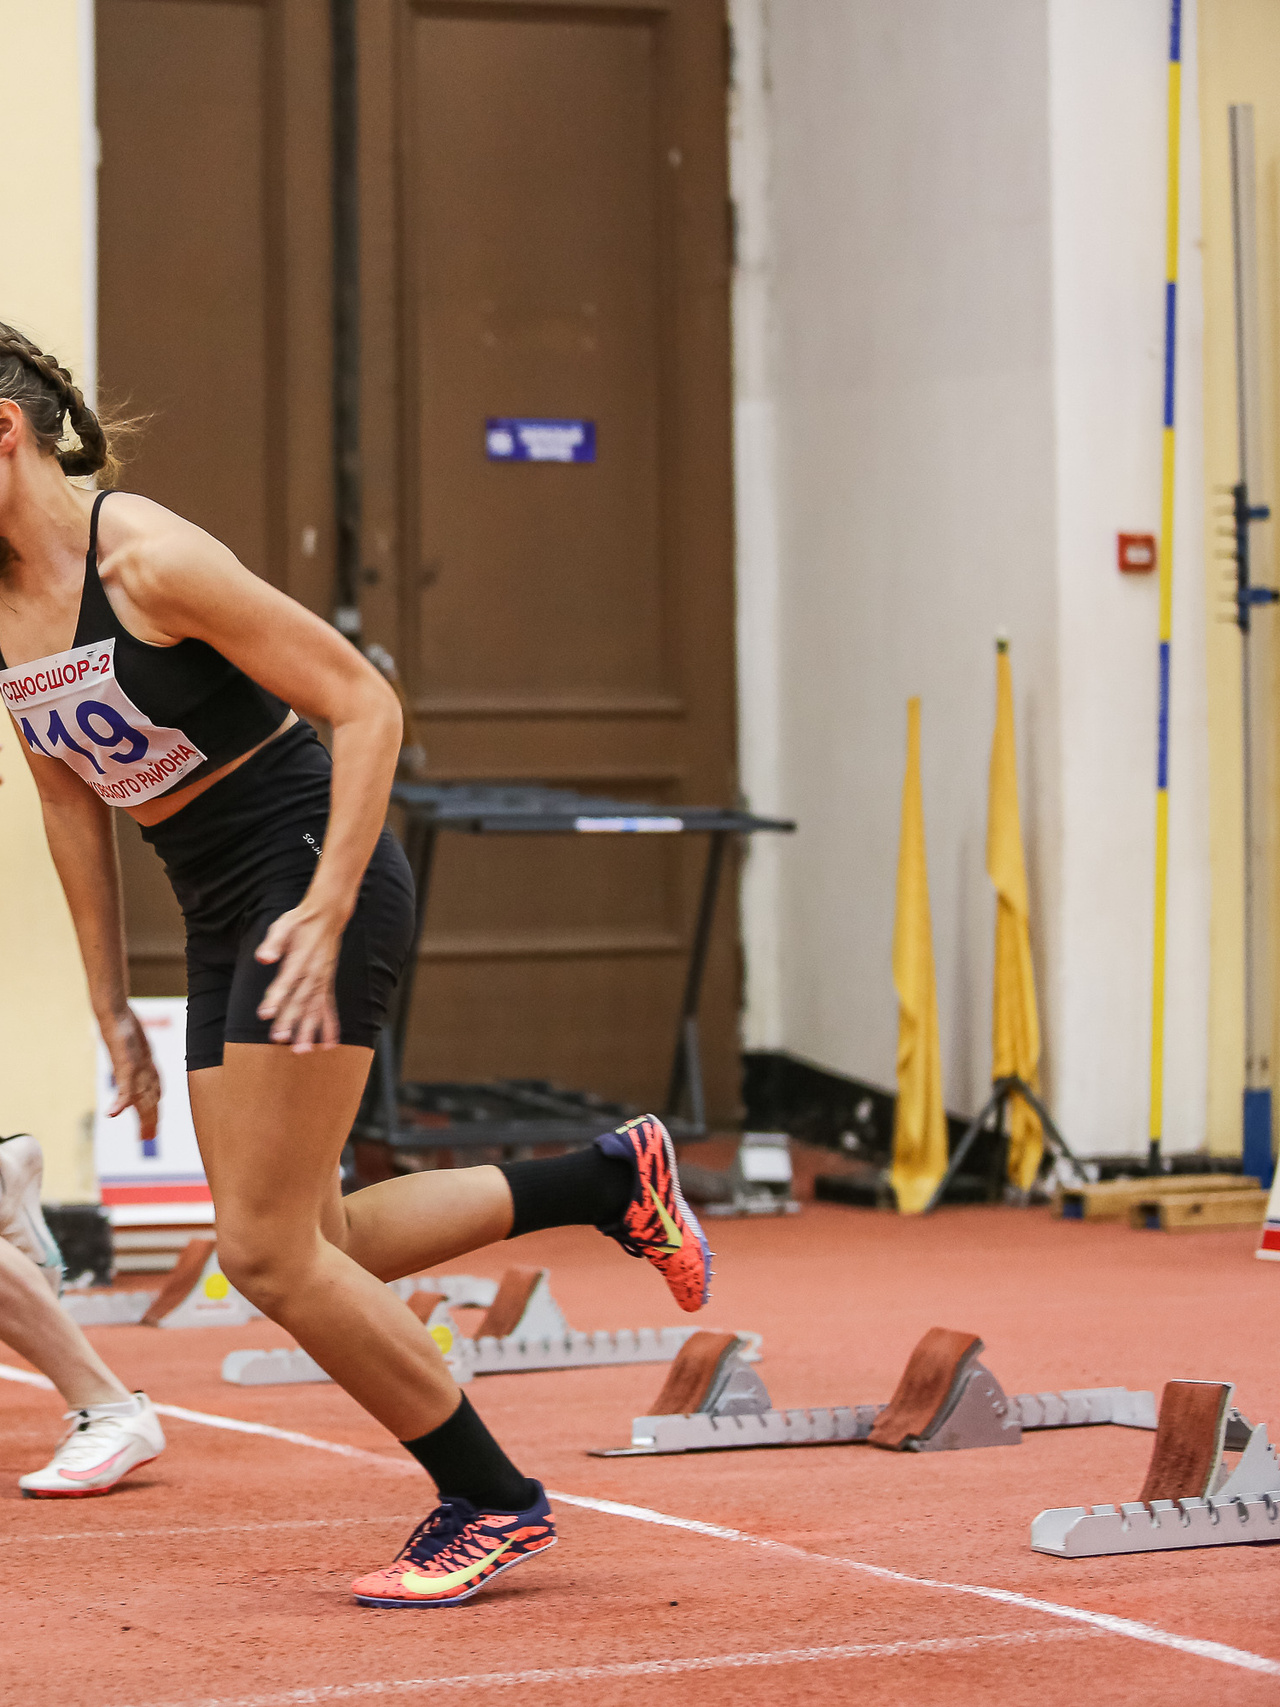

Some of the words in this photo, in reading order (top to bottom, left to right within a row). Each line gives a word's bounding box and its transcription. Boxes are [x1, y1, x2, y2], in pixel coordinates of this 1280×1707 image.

[2, 653, 111, 703] СДЮСШОР-2
[20, 699, 150, 775] 119
[134, 743, 197, 789] РАЙОНА
